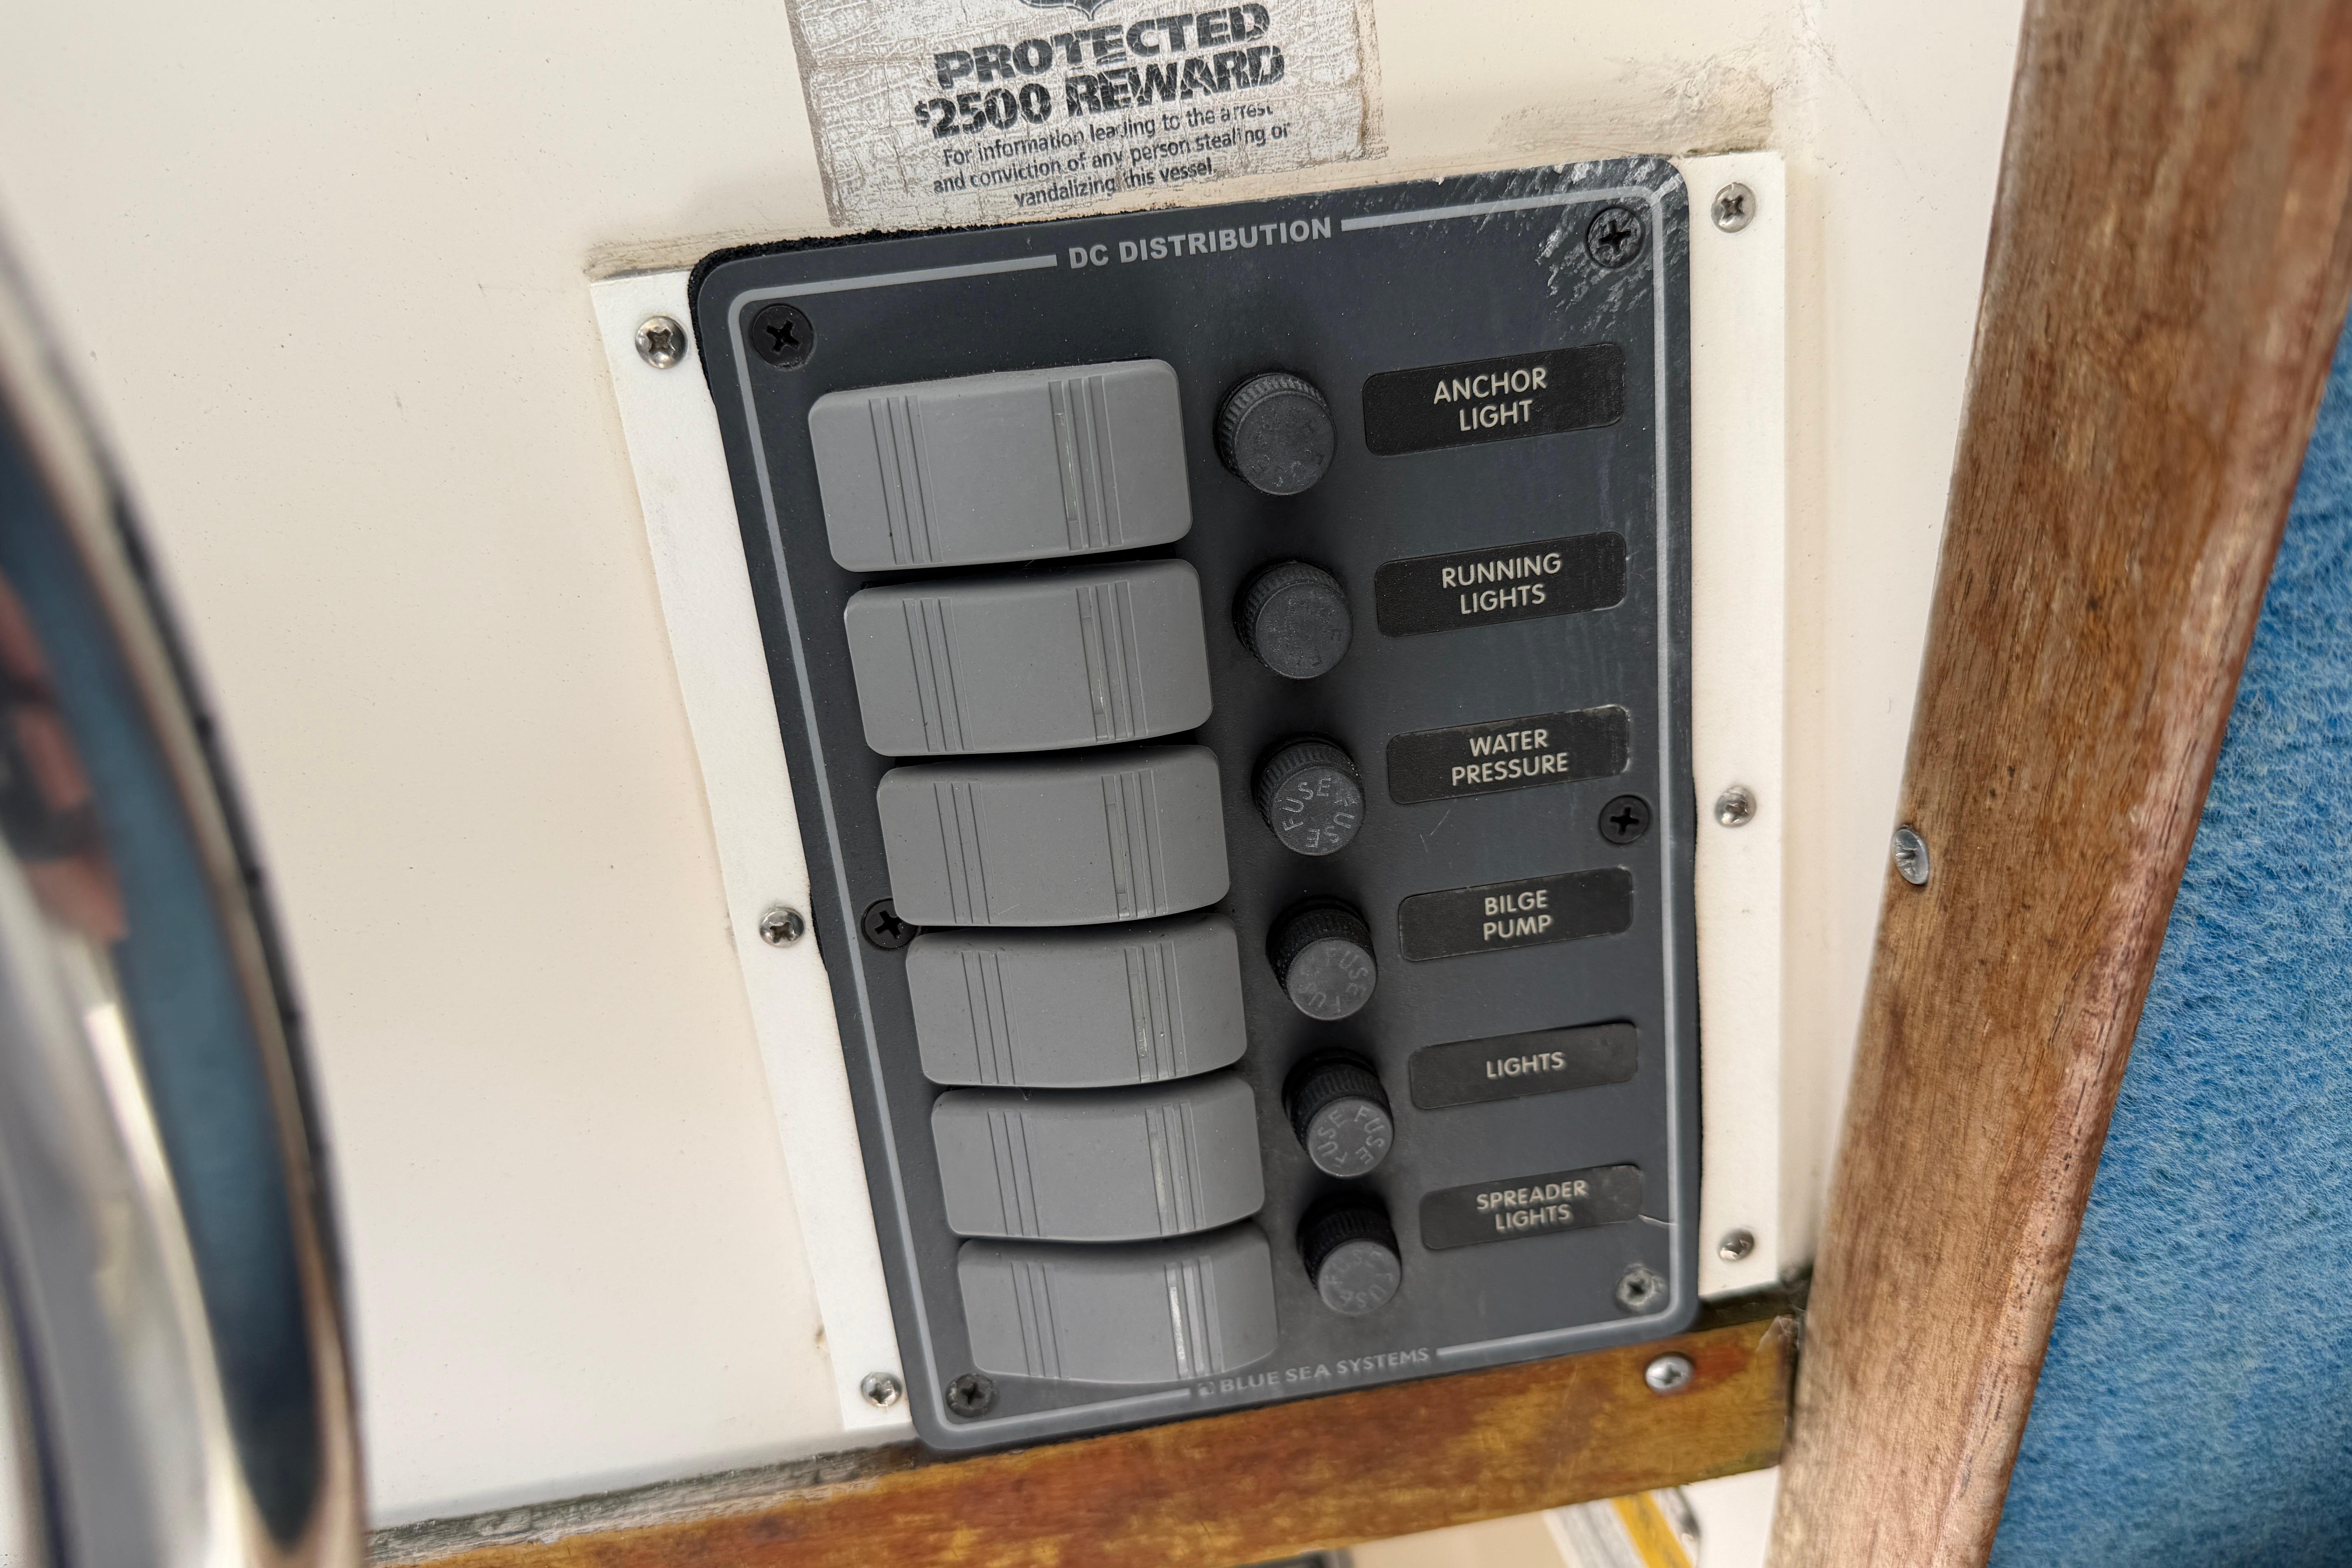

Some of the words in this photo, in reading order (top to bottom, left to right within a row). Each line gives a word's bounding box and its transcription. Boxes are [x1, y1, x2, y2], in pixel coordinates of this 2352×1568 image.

[934, 3, 1270, 89] PROTECTED
[915, 83, 1052, 139] $2500
[1066, 45, 1285, 117] REWARD
[943, 148, 973, 167] For
[977, 129, 1084, 162] information
[1162, 114, 1180, 132] to
[1185, 107, 1215, 128] the
[933, 171, 966, 194] and
[970, 160, 1062, 187] conviction
[1068, 152, 1087, 172] of
[1129, 139, 1191, 166] person
[1195, 127, 1267, 152] stealing
[1271, 122, 1290, 140] or
[1014, 177, 1116, 208] vandalizing
[1123, 167, 1155, 189] this
[1069, 244, 1109, 269] DC
[1119, 217, 1331, 263] DISTRIBUTION
[1433, 368, 1547, 405] ANCHOR
[1459, 400, 1533, 432] LIGHT
[1442, 553, 1561, 588] RUNNING
[1460, 584, 1546, 614] LIGHTS
[1469, 729, 1547, 757] WATER
[1452, 753, 1568, 786] PRESSURE
[1281, 777, 1331, 831] FUSE
[1485, 889, 1549, 916] BILGE
[1483, 914, 1552, 940] PUMP
[1486, 1052, 1566, 1080] LIGHTS
[1354, 1105, 1385, 1164] FUSE
[1476, 1180, 1589, 1211] SPREADER
[1496, 1204, 1574, 1233] LIGHTS
[1220, 1371, 1280, 1393] BLUE
[1285, 1363, 1331, 1382] SEA
[1336, 1347, 1430, 1374] SYSTEMS
